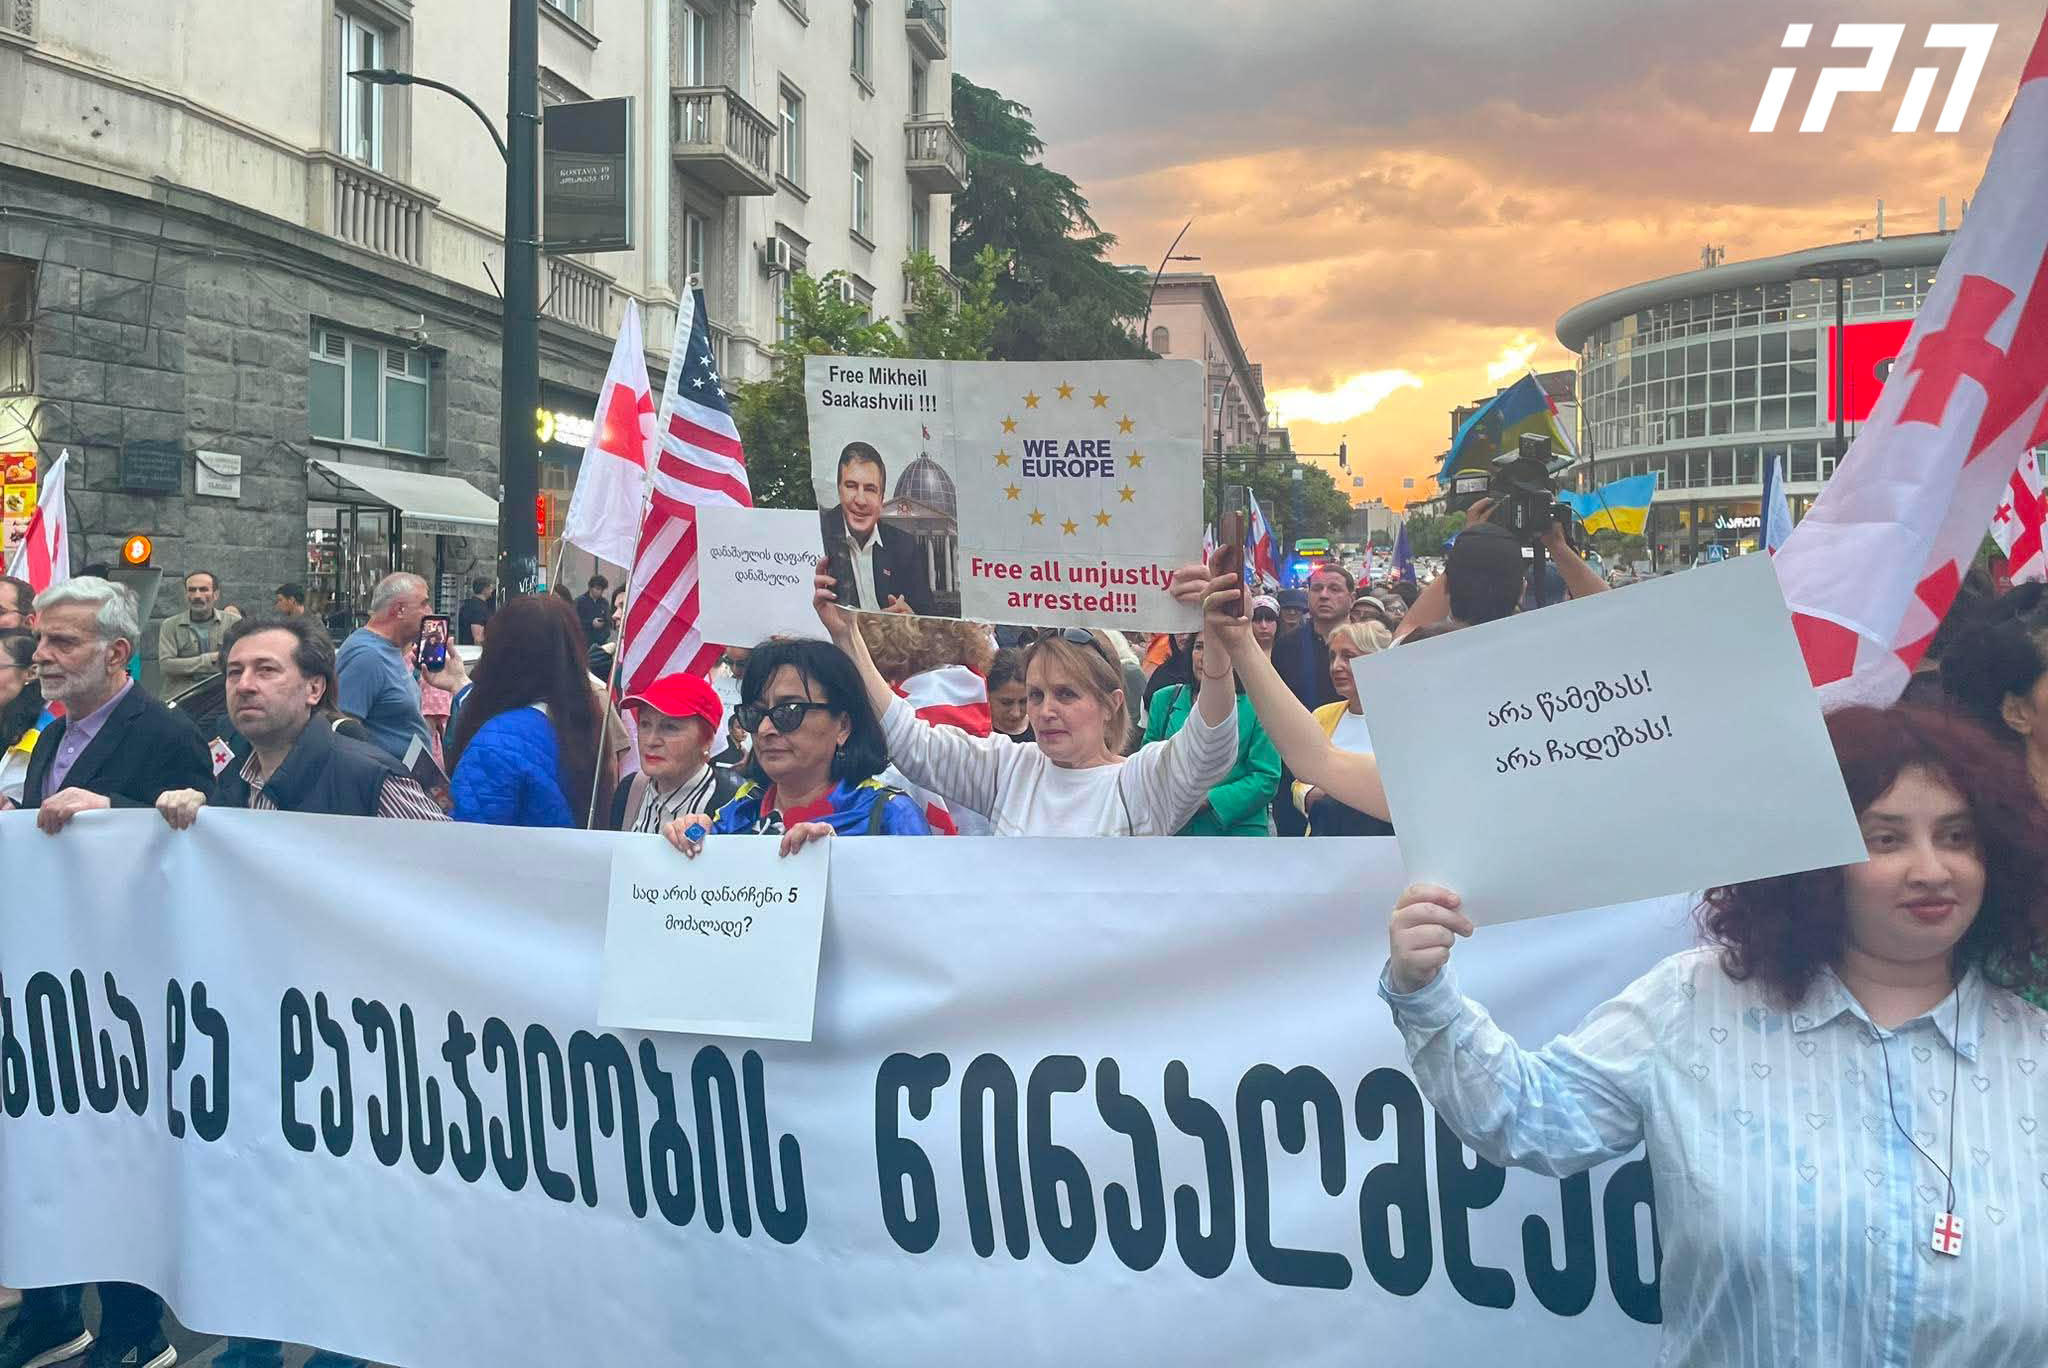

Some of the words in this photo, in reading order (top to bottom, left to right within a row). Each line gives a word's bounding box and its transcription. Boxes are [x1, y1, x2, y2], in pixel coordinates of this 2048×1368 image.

[560, 167, 599, 177] KOSTAVA
[829, 365, 864, 384] Free
[869, 367, 927, 387] Mikheil
[822, 390, 913, 411] Saakashvili
[919, 395, 937, 412] !!!
[1023, 440, 1059, 458] WE
[1064, 440, 1111, 458] ARE
[1023, 460, 1115, 477] EUROPE
[710, 545, 771, 563] დანაშაულის
[735, 569, 800, 586] დანაშაულია
[972, 558, 1022, 580] Free
[1030, 561, 1061, 582] all
[1069, 561, 1174, 591] unjustly
[1008, 591, 1137, 614] arrested!!!
[1488, 701, 1532, 727] არა
[1536, 670, 1652, 722] წამებას!
[1496, 747, 1541, 773] არა
[1546, 715, 1672, 762] ჩადებას!
[632, 884, 659, 904] სად
[662, 885, 697, 901] არის
[701, 886, 783, 908] დანარჩენი
[788, 887, 798, 903] 5
[665, 914, 753, 937] მოძალადე?
[167, 978, 229, 1142] და
[281, 987, 808, 1245] დაუსჯელობის
